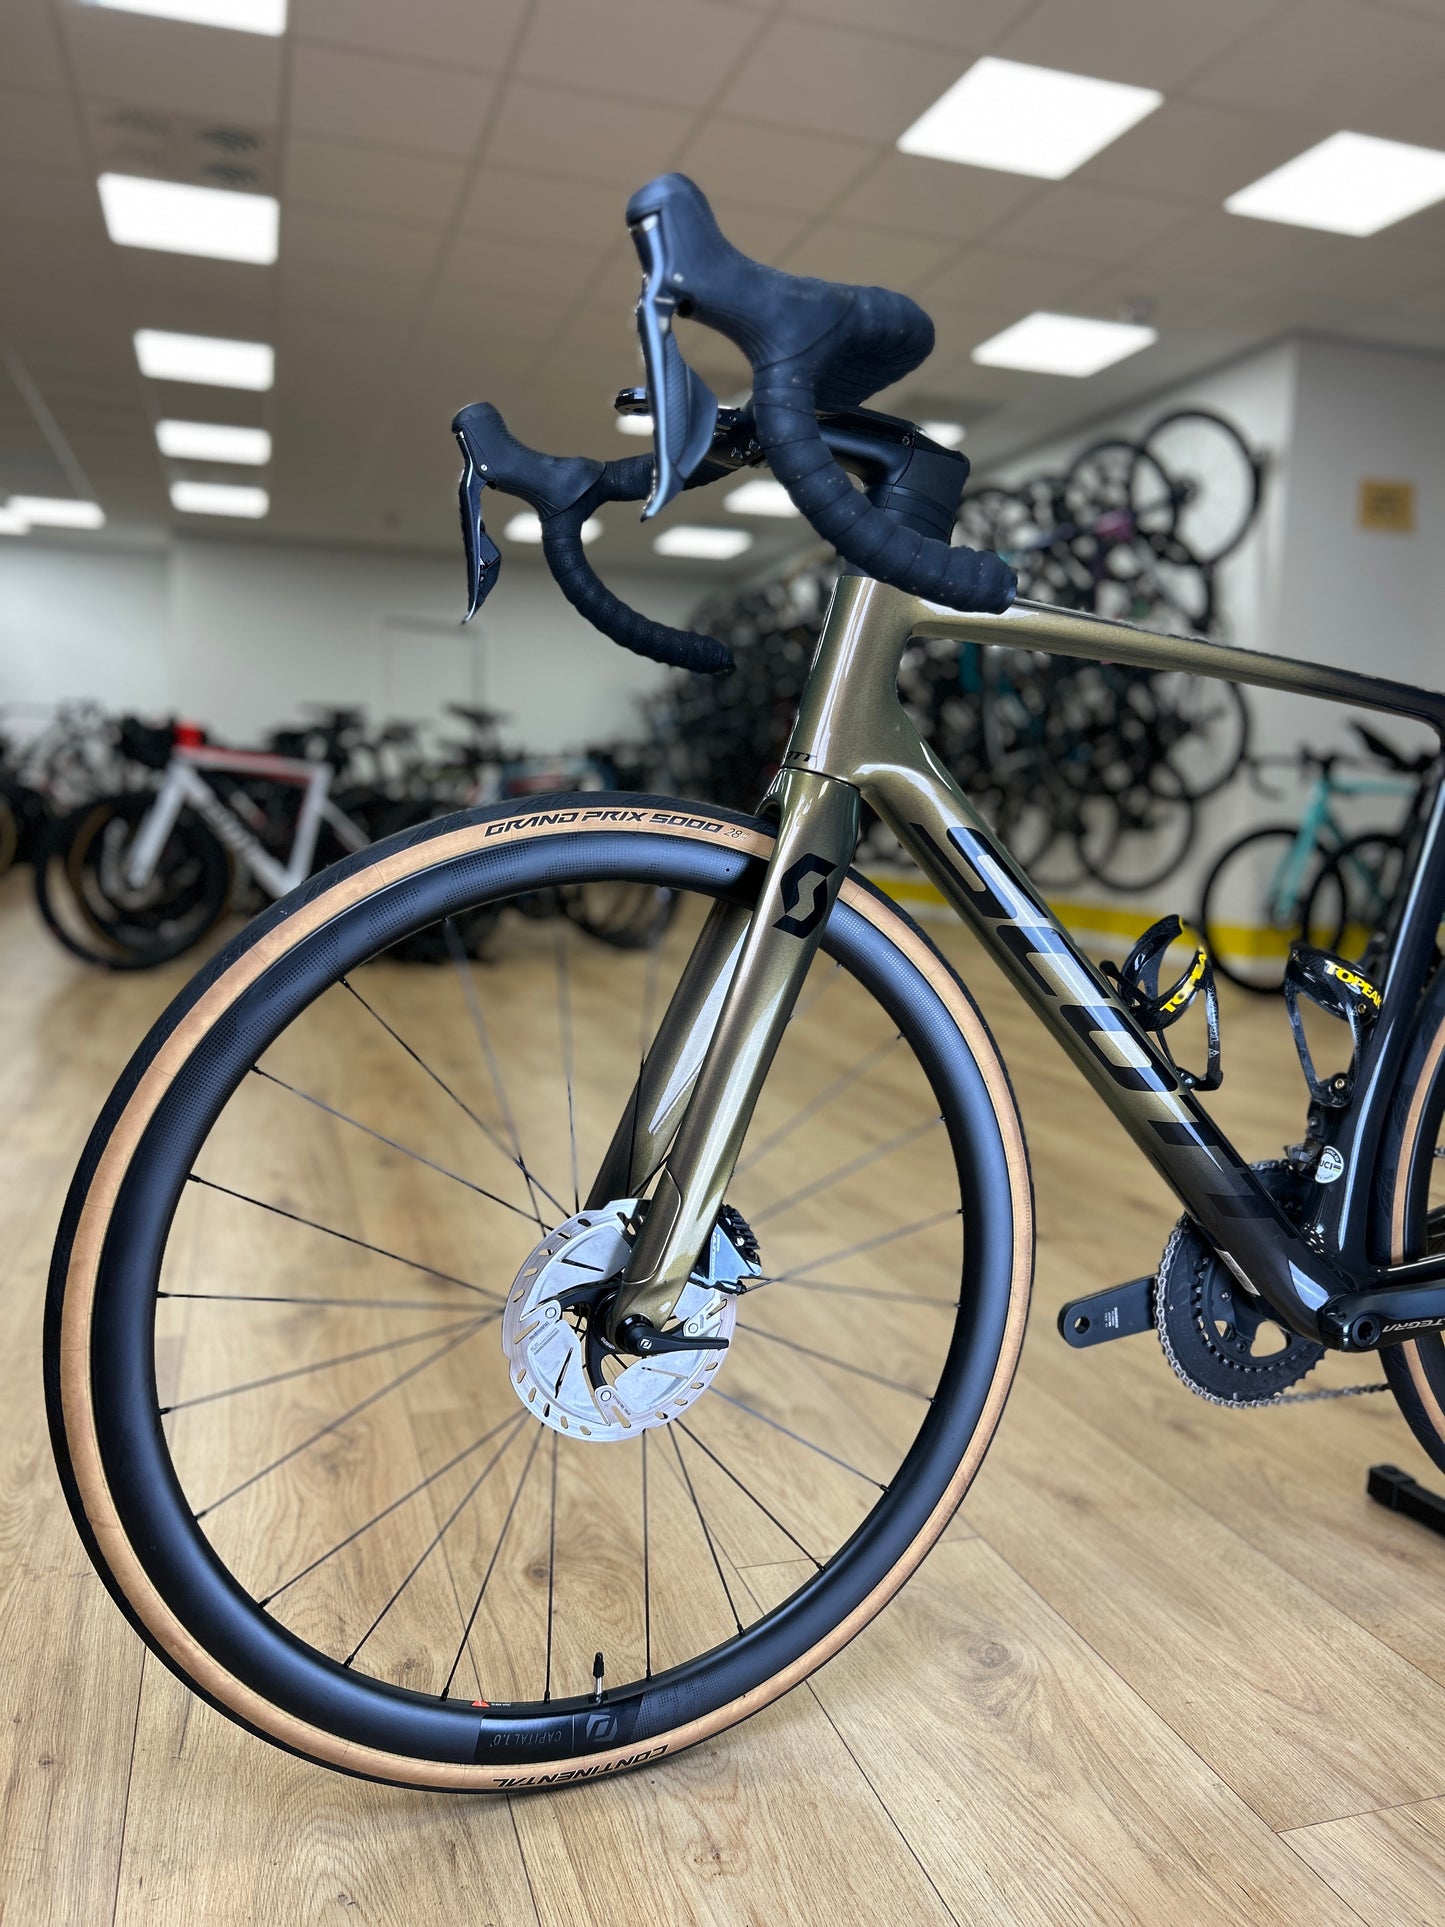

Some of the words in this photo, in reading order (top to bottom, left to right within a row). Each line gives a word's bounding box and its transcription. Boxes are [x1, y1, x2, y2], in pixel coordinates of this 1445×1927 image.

[485, 812, 579, 837] GRAND
[581, 811, 649, 822] PRIX
[649, 814, 724, 834] 5000
[910, 823, 1305, 1240] SCOTT
[515, 1730, 562, 1745] CAPITAL
[493, 1744, 669, 1788] CONTINENTAL
